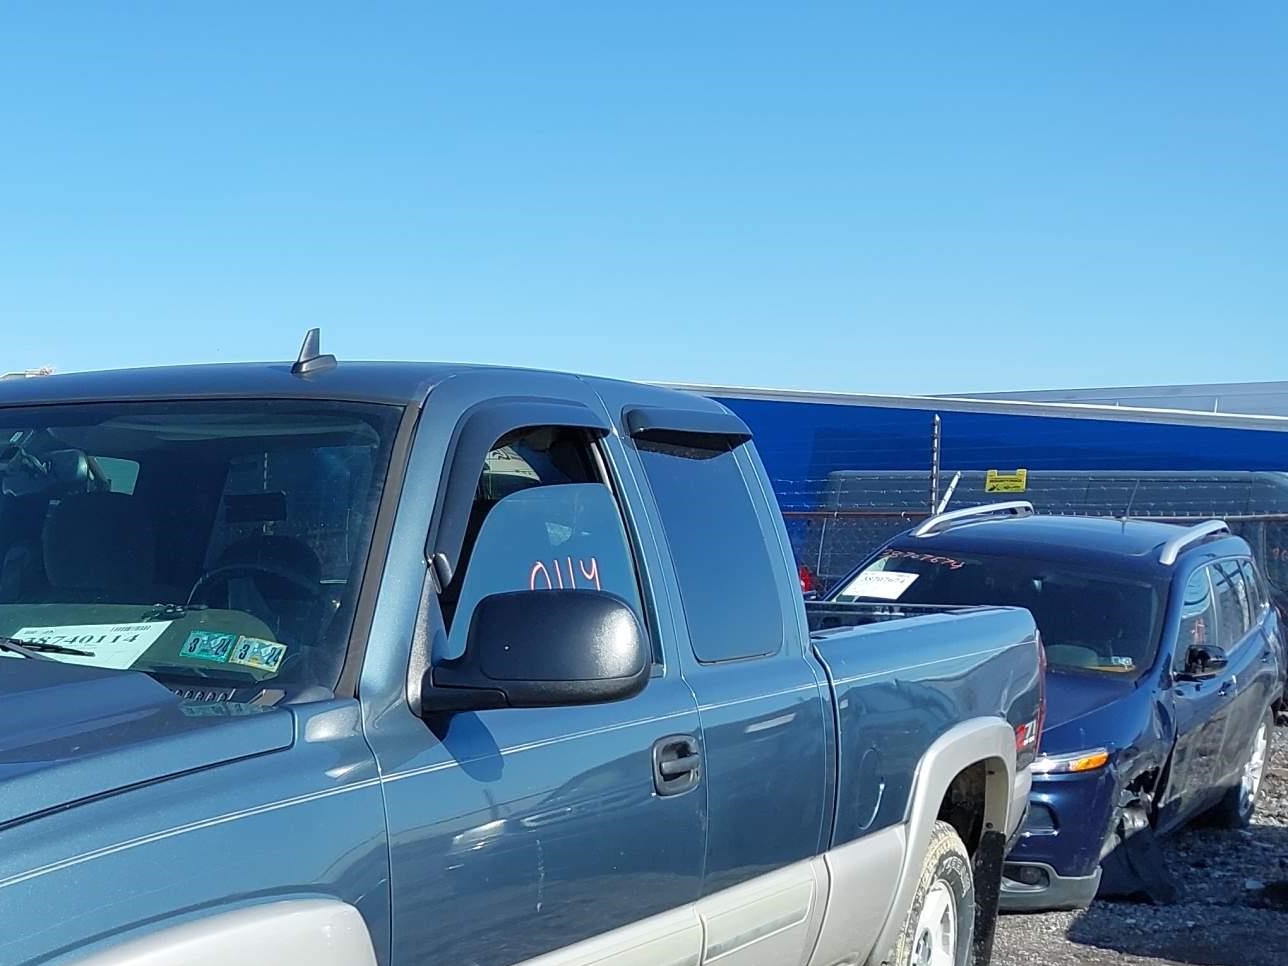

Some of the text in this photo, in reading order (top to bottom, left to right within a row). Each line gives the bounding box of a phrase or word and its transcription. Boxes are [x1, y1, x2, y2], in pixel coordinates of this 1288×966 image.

[530, 556, 602, 592] 0114
[188, 637, 232, 657] 3 24
[238, 643, 283, 666] 3 24
